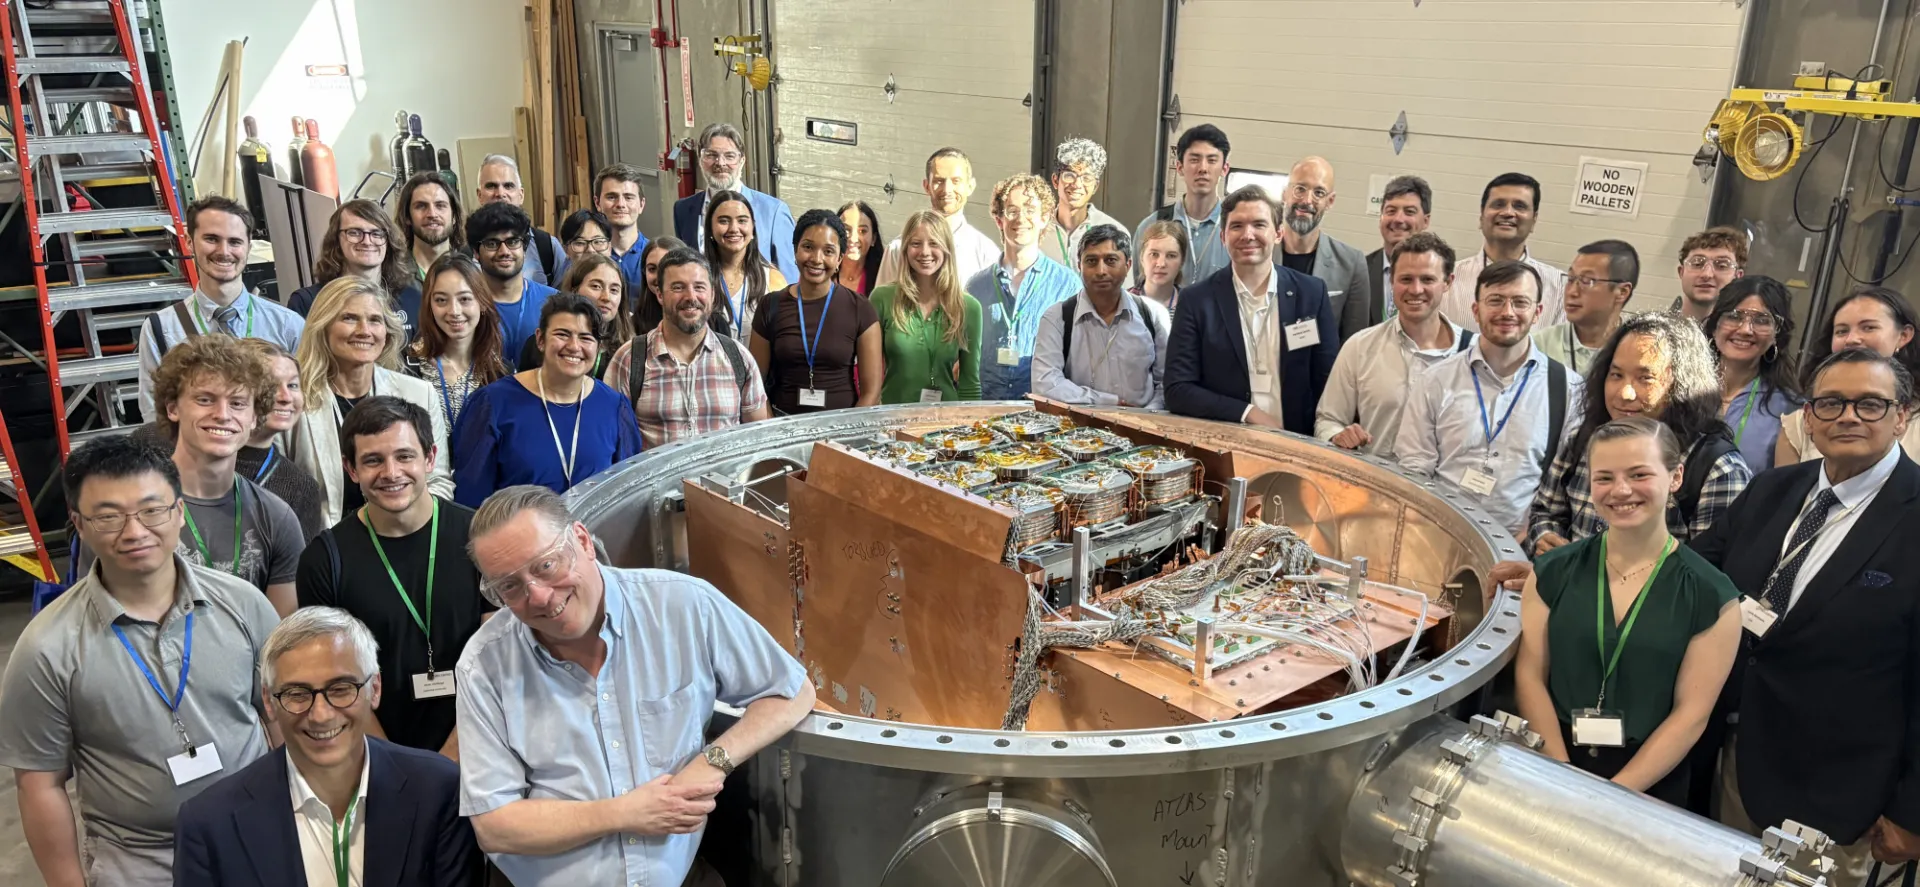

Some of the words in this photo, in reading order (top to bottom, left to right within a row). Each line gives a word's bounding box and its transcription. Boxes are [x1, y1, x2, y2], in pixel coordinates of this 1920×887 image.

[1602, 169, 1620, 180] NO
[1583, 180, 1635, 196] WOODEN
[1581, 194, 1631, 210] PALLETS
[1153, 792, 1207, 822] ATLAS
